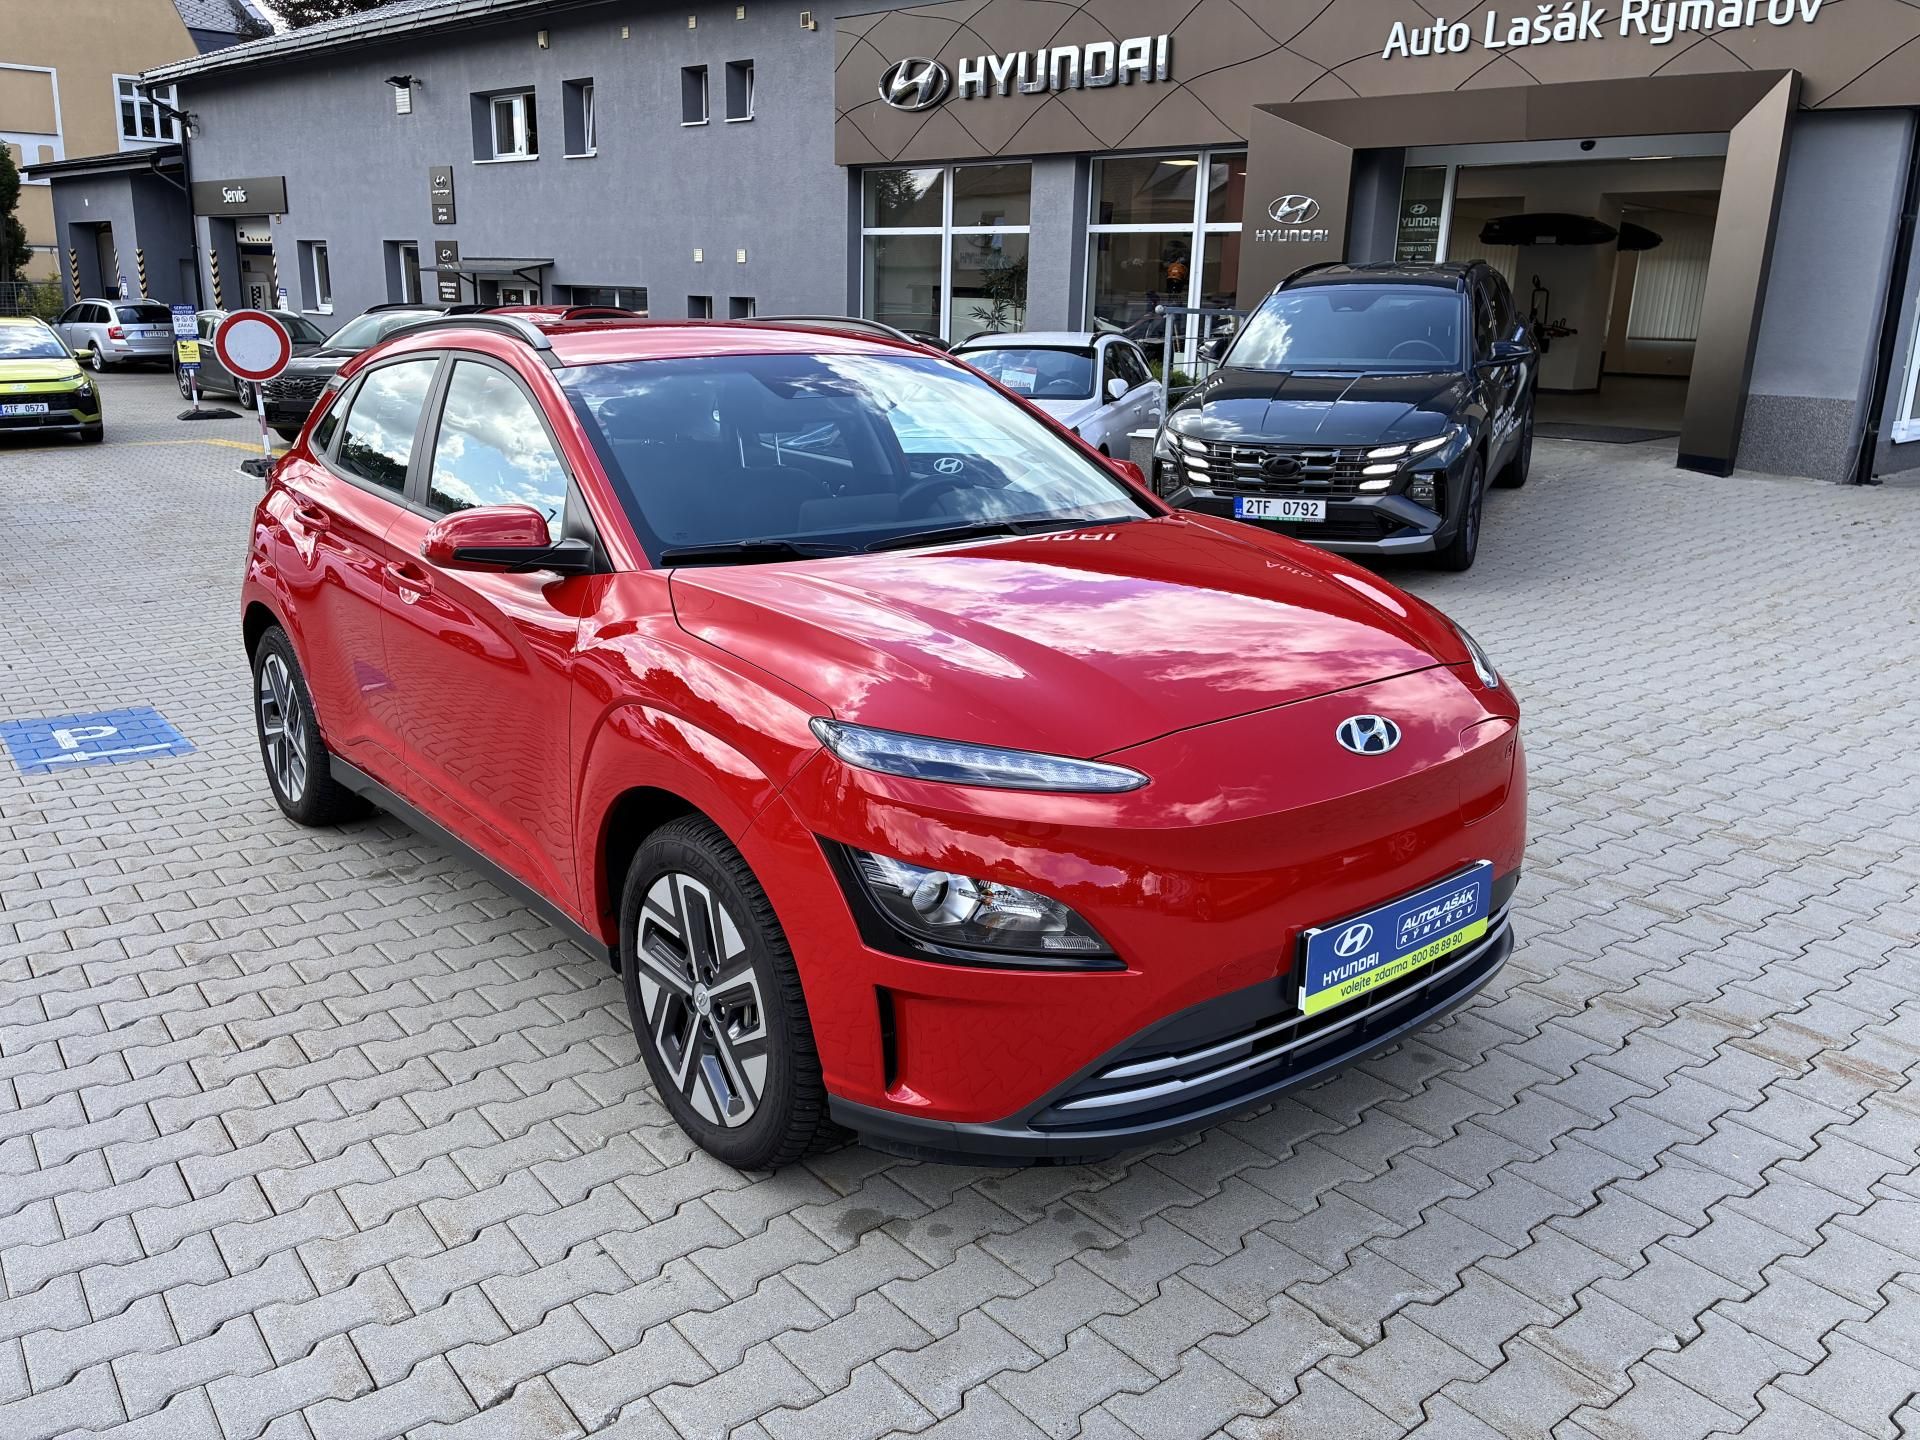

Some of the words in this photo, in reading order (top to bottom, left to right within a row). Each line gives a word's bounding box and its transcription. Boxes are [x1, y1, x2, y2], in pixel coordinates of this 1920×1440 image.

[1381, 21, 1470, 59] Auto
[1483, 0, 1607, 50] Lašák
[958, 33, 1170, 99] HYUNDAI
[222, 186, 247, 203] Servis
[1255, 229, 1329, 242] HYUNDAI
[4, 405, 18, 413] 2TF
[25, 404, 45, 412] 0573
[1246, 500, 1272, 514] 2TF
[1282, 501, 1319, 516] 0792
[1400, 905, 1474, 945] RÝMAŘOV
[1401, 889, 1475, 932] AUTOLAŠÁK
[1322, 951, 1379, 987] HYUNDAI
[1340, 976, 1371, 997] volejte
[1374, 960, 1408, 983] zdarma
[1411, 948, 1428, 966] 800
[1429, 943, 1440, 957] 88
[1440, 937, 1451, 952] 89
[1452, 932, 1463, 946] 90
